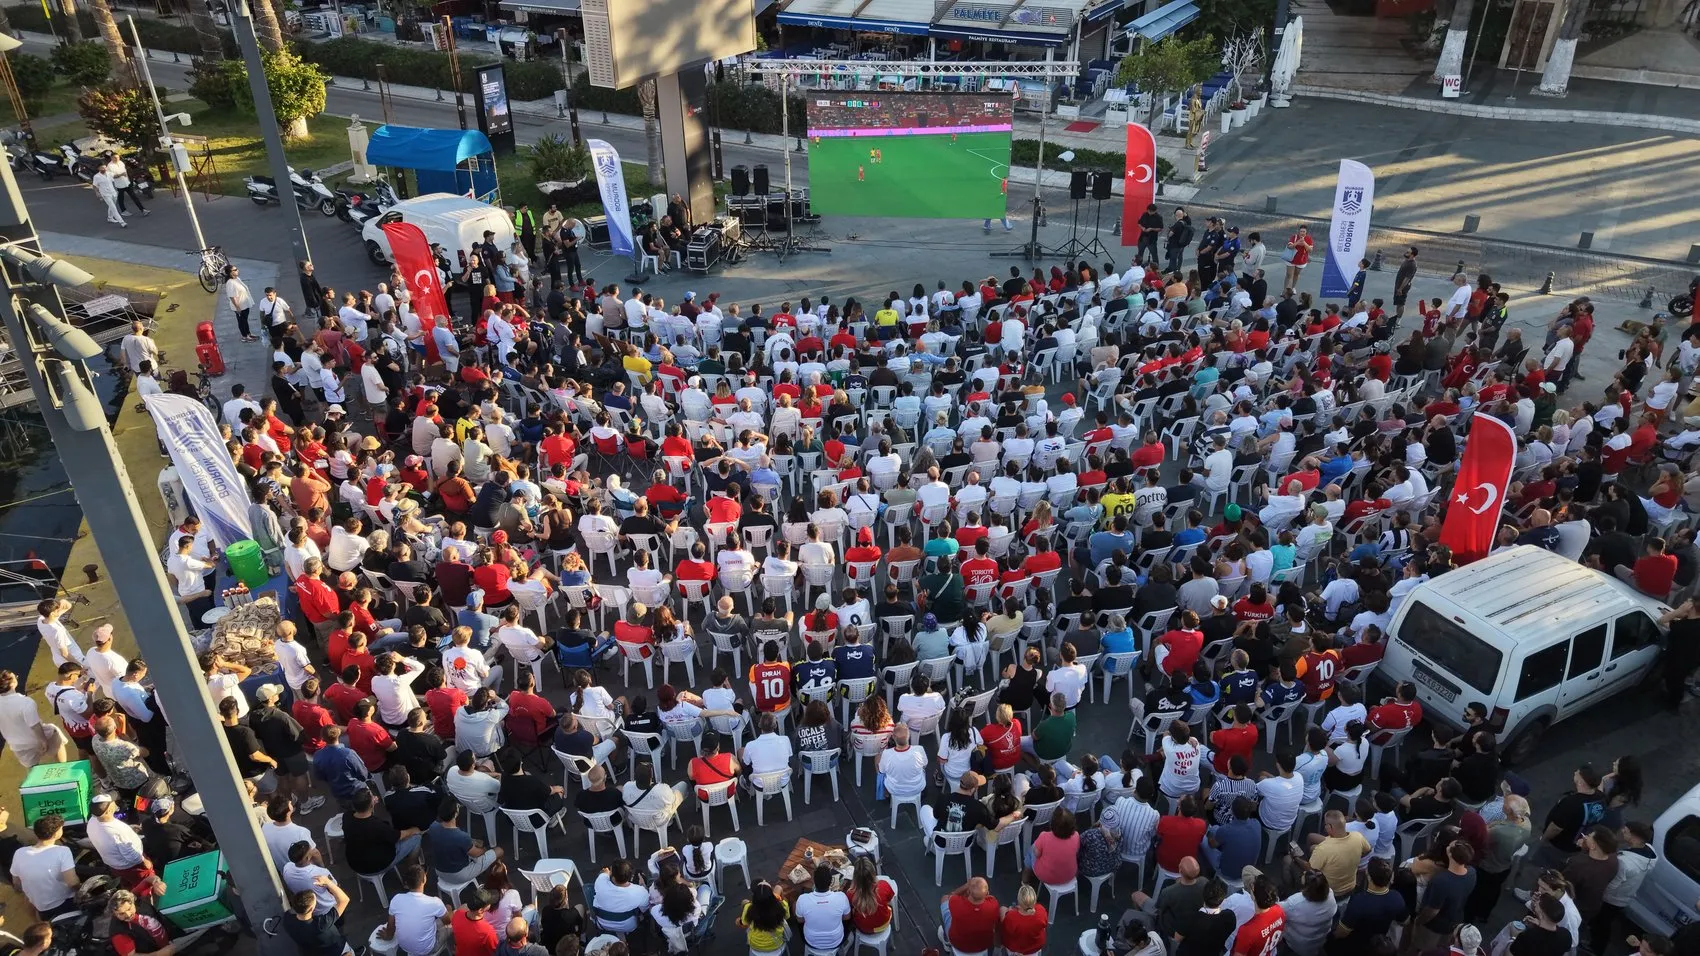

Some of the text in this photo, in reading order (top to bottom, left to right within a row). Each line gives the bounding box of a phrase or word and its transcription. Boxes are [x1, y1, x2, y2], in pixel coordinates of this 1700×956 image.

[954, 8, 999, 21] PALMİYE
[989, 36, 1018, 44] RESTAURANT
[1444, 78, 1460, 87] WC
[761, 669, 782, 678] EMRAH
[1315, 659, 1334, 682] 10
[761, 678, 784, 700] 10
[799, 725, 825, 739] LOCALS
[799, 733, 827, 747] COFFEE
[1174, 760, 1193, 769] ego
[1173, 768, 1188, 776] ne
[38, 799, 65, 808] Uber
[40, 807, 67, 816] Eats
[178, 869, 190, 893] Uber
[188, 865, 201, 890] Eats
